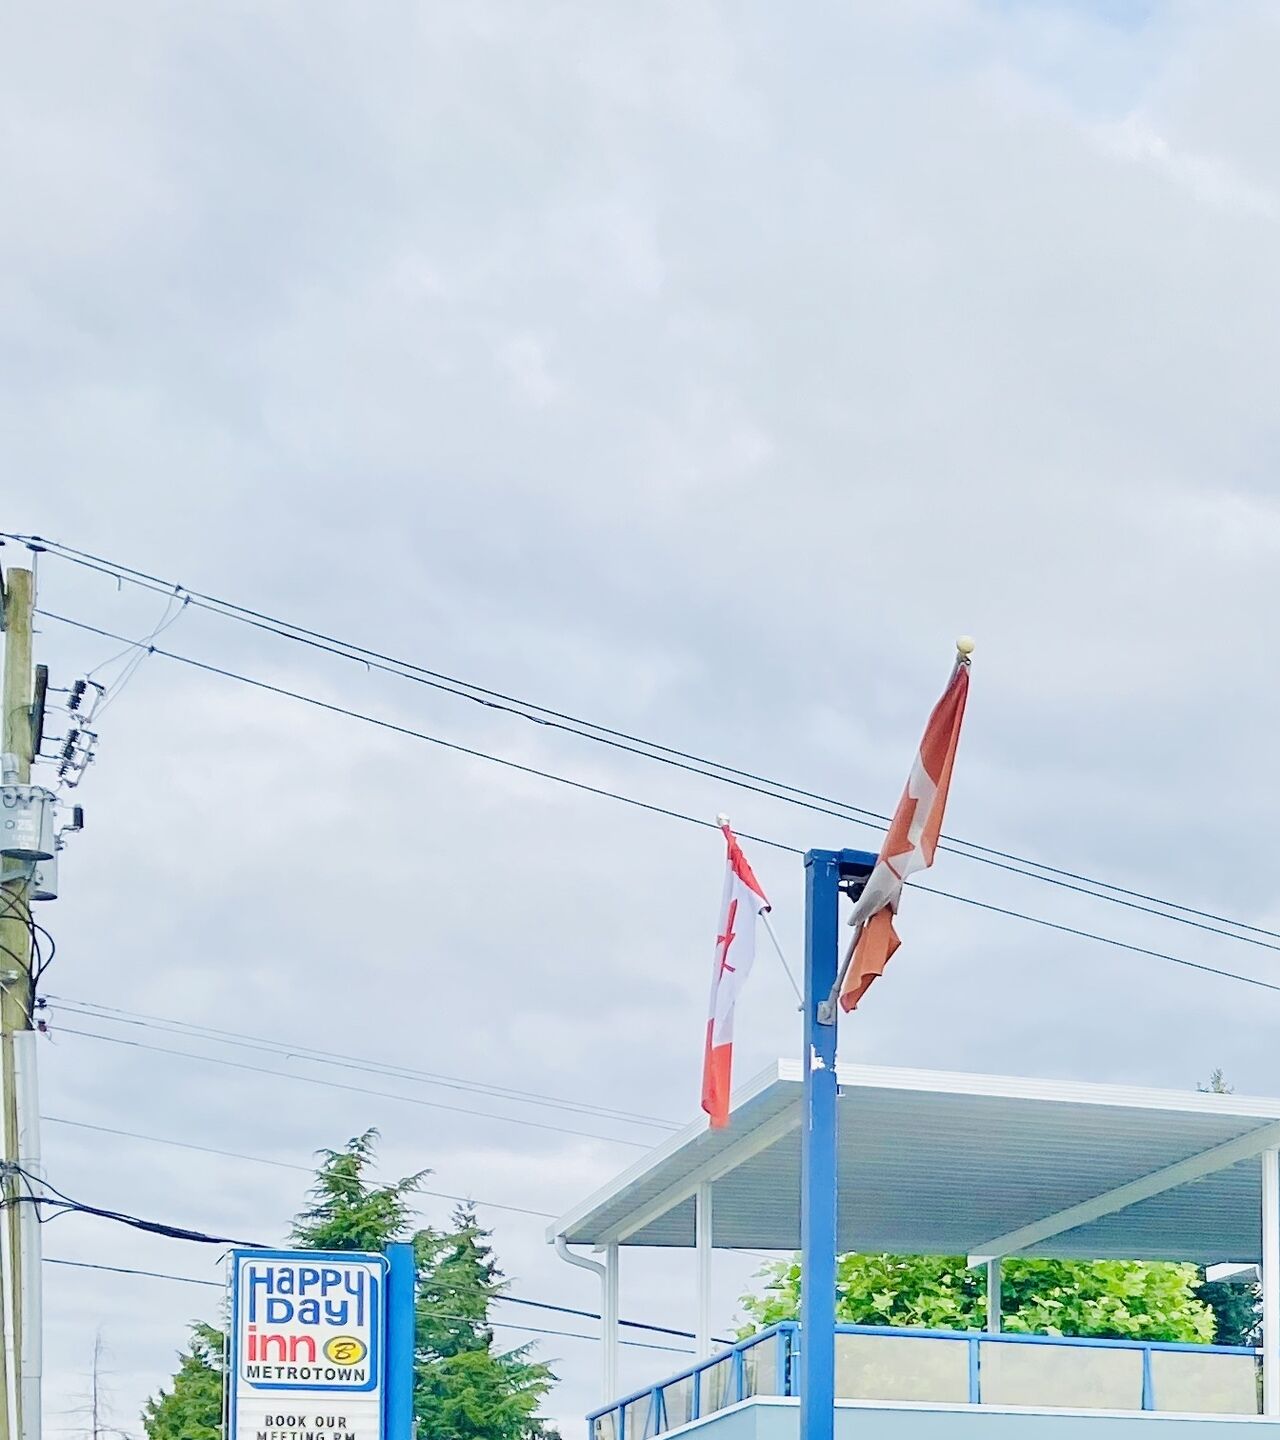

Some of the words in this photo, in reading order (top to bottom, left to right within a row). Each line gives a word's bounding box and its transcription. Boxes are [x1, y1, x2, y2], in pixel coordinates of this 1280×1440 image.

[266, 1298, 348, 1326] Day
[248, 1326, 316, 1362] inn
[247, 1365, 365, 1382] METROTOWN
[265, 1415, 307, 1428] BOOK
[315, 1416, 347, 1429] OUR
